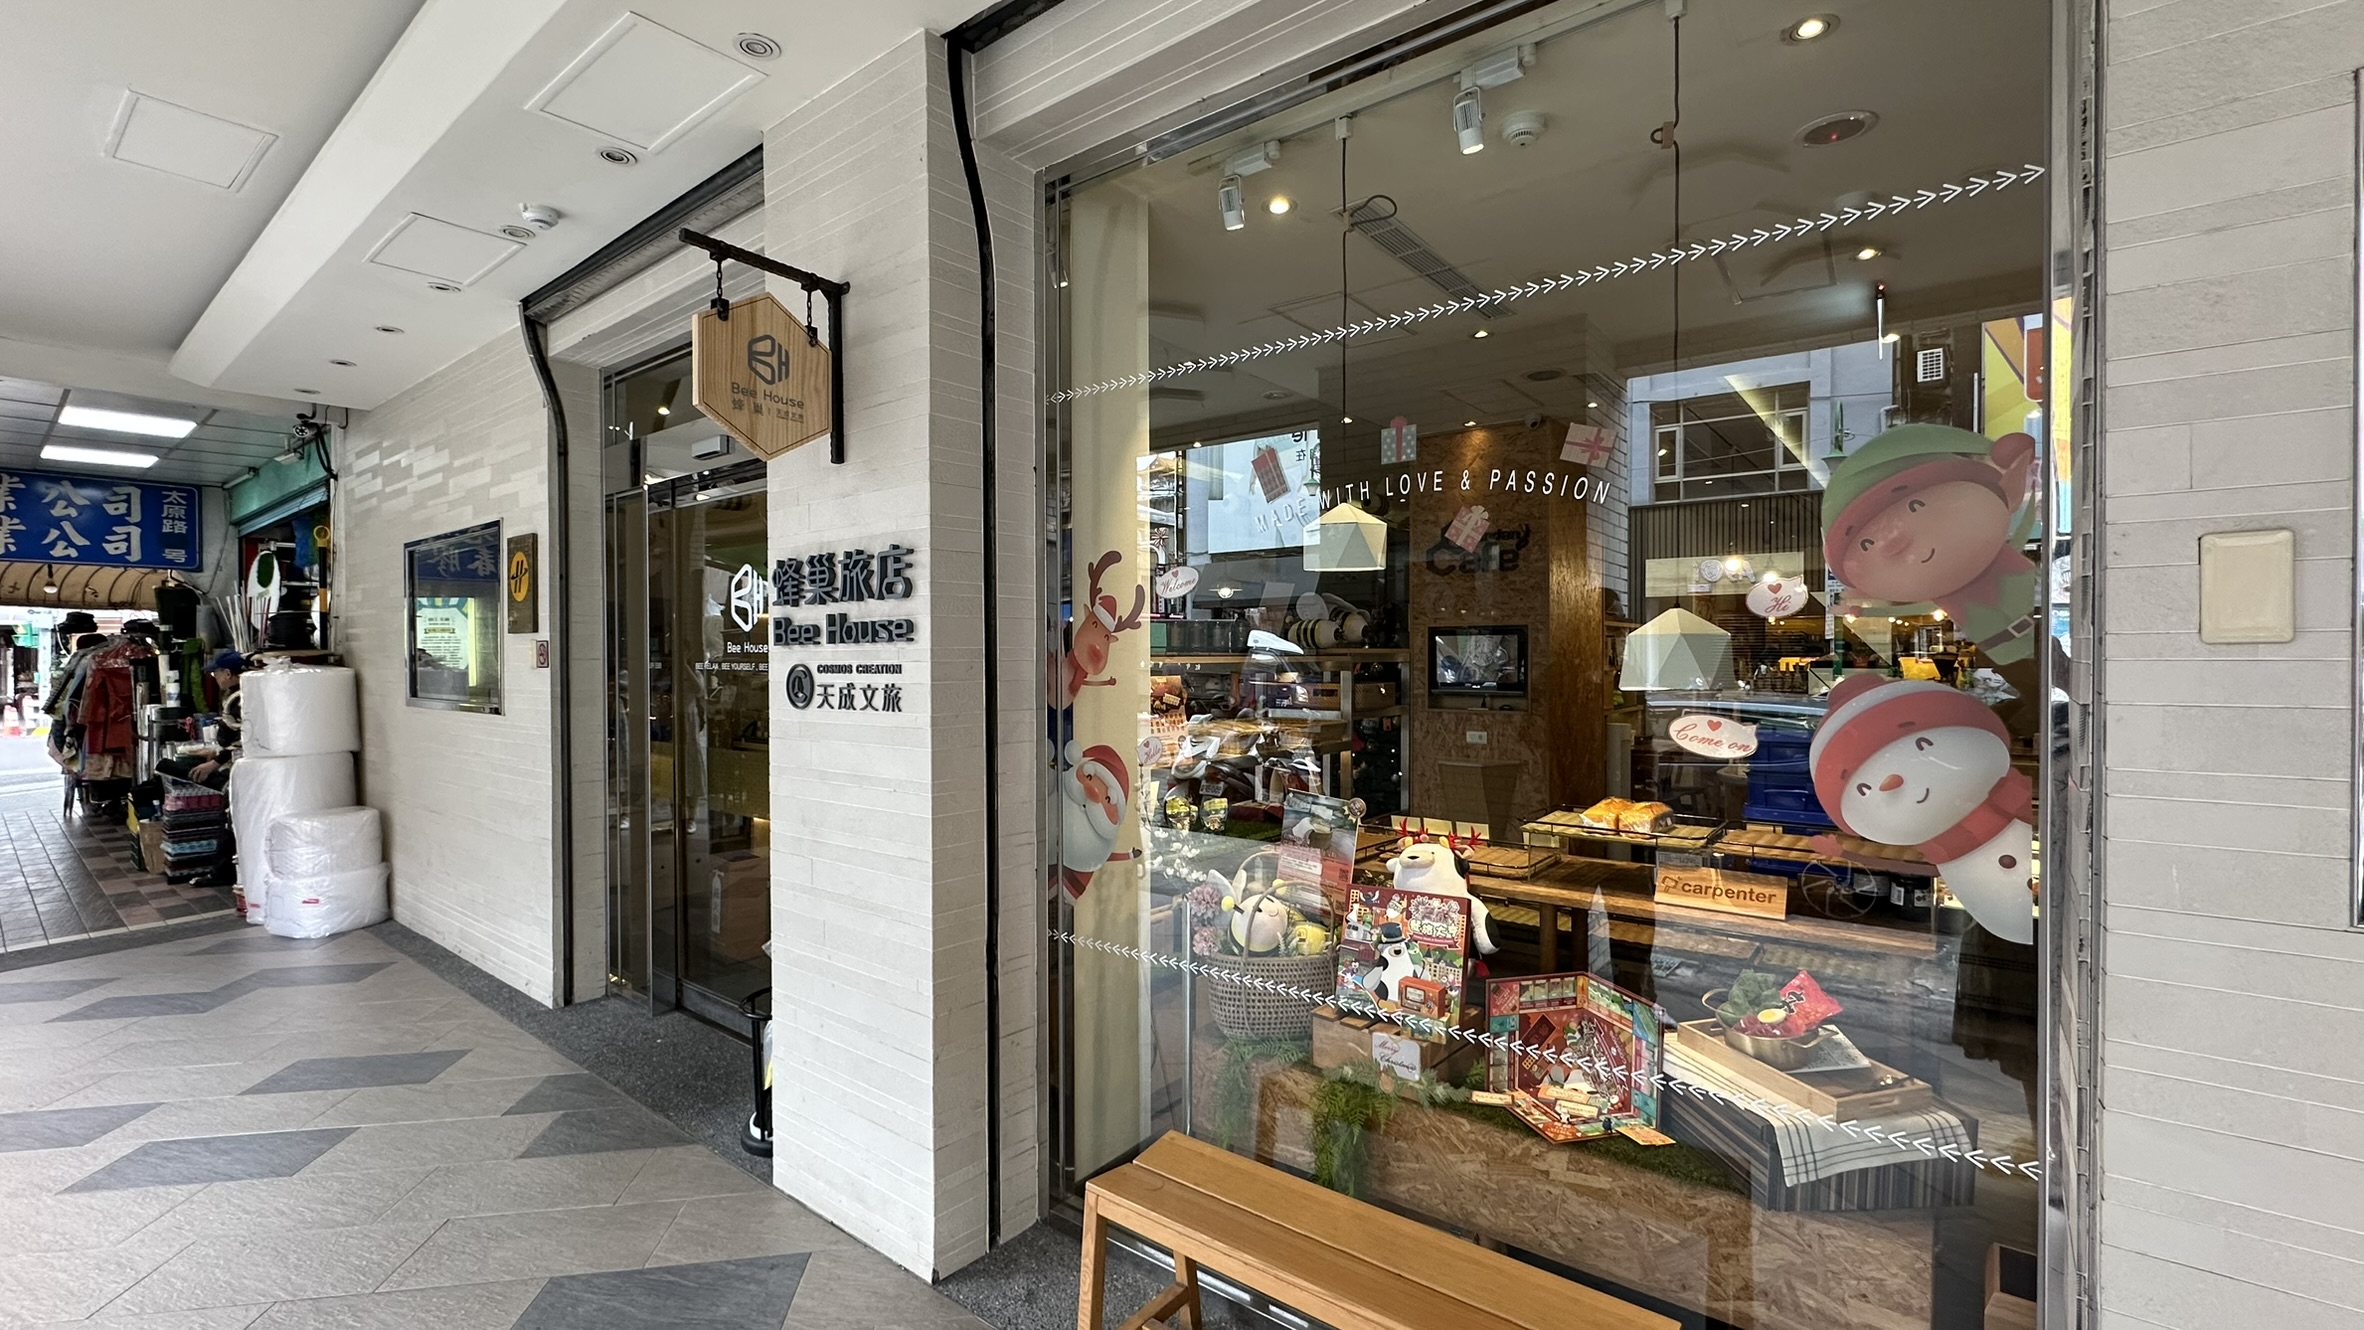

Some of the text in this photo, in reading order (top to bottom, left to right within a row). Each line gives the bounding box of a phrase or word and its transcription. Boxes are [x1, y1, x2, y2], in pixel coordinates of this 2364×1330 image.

[731, 382, 804, 409] Bee House
[1255, 469, 1610, 534] MADE WITH LOVE & PASSION
[772, 544, 914, 607] 蜂巢旅店
[1160, 578, 1196, 595] Welcome
[1764, 594, 1792, 614] Hi
[773, 613, 914, 646] Bee House
[727, 641, 768, 653] Bee House
[695, 662, 703, 670] BEE
[721, 662, 730, 670] BEE
[731, 662, 755, 671] YOURSELF
[817, 664, 902, 675] COSMOS CREATION
[817, 682, 902, 712] 天成文旅
[1673, 723, 1753, 752] Come on
[1144, 745, 1161, 764] Hello
[1681, 882, 1777, 904] carpenter
[1375, 1040, 1400, 1055] Merry
